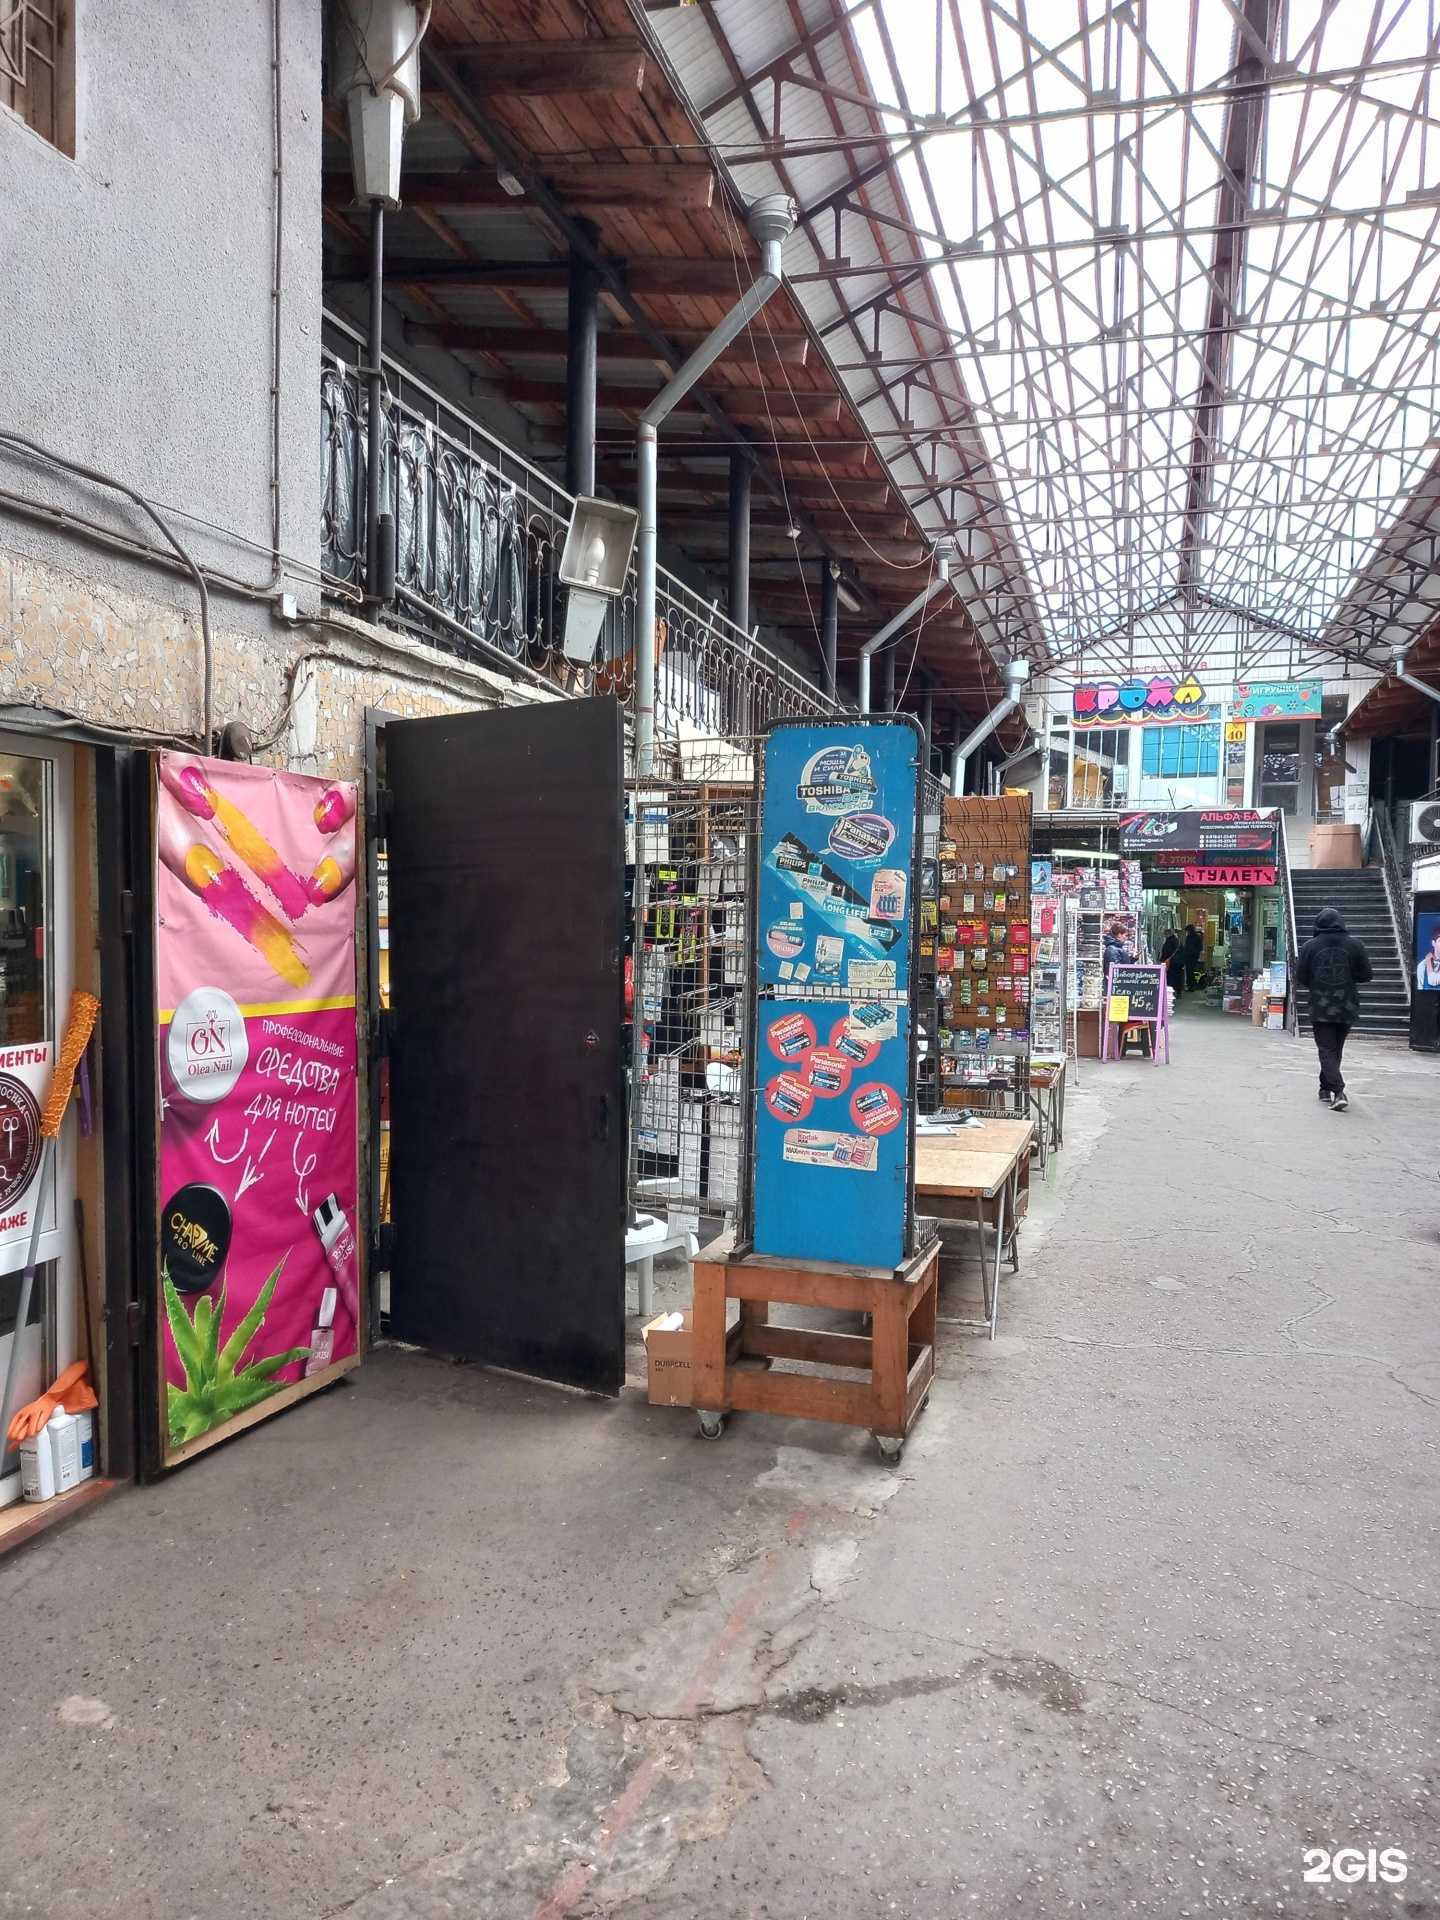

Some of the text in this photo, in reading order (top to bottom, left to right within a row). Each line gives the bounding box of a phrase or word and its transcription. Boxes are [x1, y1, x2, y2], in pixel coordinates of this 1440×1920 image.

[1074, 674, 1204, 712] КРОХА
[1252, 684, 1299, 694] ИГРУШКИ
[1228, 730, 1242, 740] 40
[839, 774, 873, 786] TOSHIBA
[800, 785, 850, 797] TOSHIBA
[844, 821, 886, 849] Panasonic
[779, 857, 807, 868] PHILIPS
[803, 878, 828, 888] PHILIPS
[1197, 870, 1263, 881] ТУАЛЕТ
[771, 1020, 804, 1038] Panasonic
[262, 1020, 345, 1057] ПРОФЕССИОНАЛЬНЫЕ
[188, 1059, 233, 1076] Olea Nail
[255, 1047, 340, 1095] СРЕДСТВА
[810, 1056, 847, 1070] Panasonic
[777, 1077, 810, 1099] Panasonic
[244, 1093, 282, 1125] ДЛЯ
[862, 1108, 898, 1127] Panasonic
[173, 1233, 208, 1267] PRO LINE
[655, 1360, 692, 1369] DURACELL
